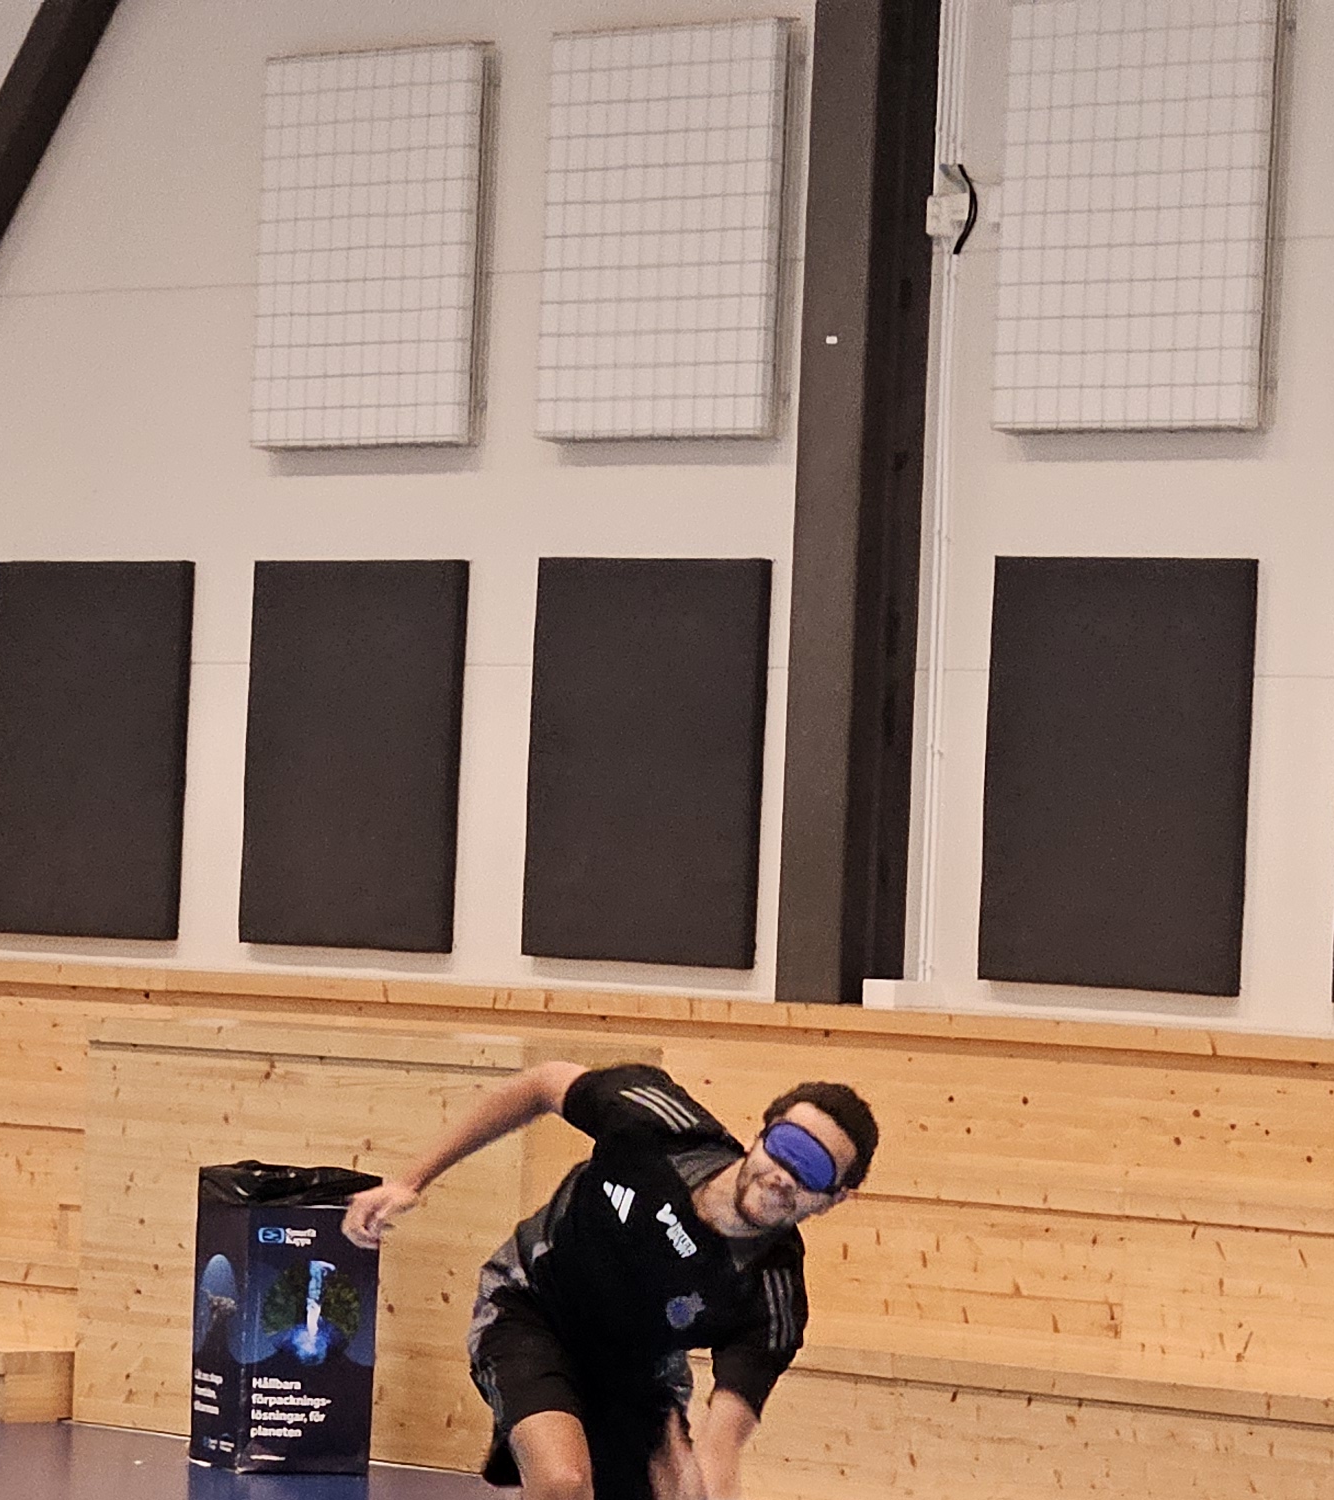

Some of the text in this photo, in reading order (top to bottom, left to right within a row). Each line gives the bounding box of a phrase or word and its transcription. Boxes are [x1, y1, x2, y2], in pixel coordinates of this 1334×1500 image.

[252, 1376, 302, 1390] Hållbara
[251, 1393, 332, 1409] förpacknings-
[251, 1408, 326, 1425] lösningar, för
[250, 1425, 302, 1438] planeten
